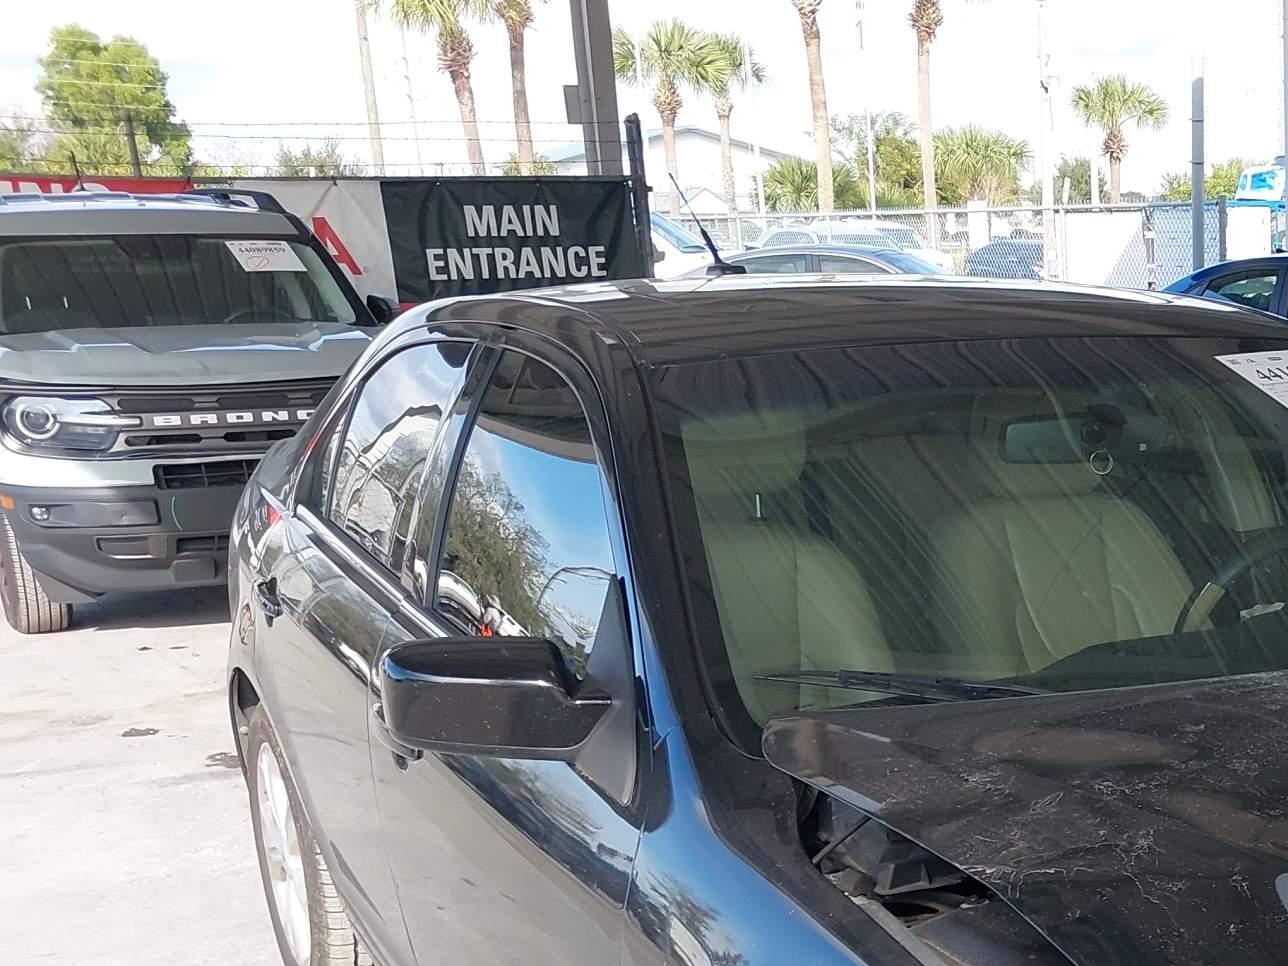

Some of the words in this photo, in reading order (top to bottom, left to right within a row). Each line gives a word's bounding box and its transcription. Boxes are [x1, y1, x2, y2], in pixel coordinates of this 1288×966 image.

[463, 205, 560, 237] MAIN
[425, 245, 608, 281] ENTRANCE
[153, 409, 315, 426] BRONC
